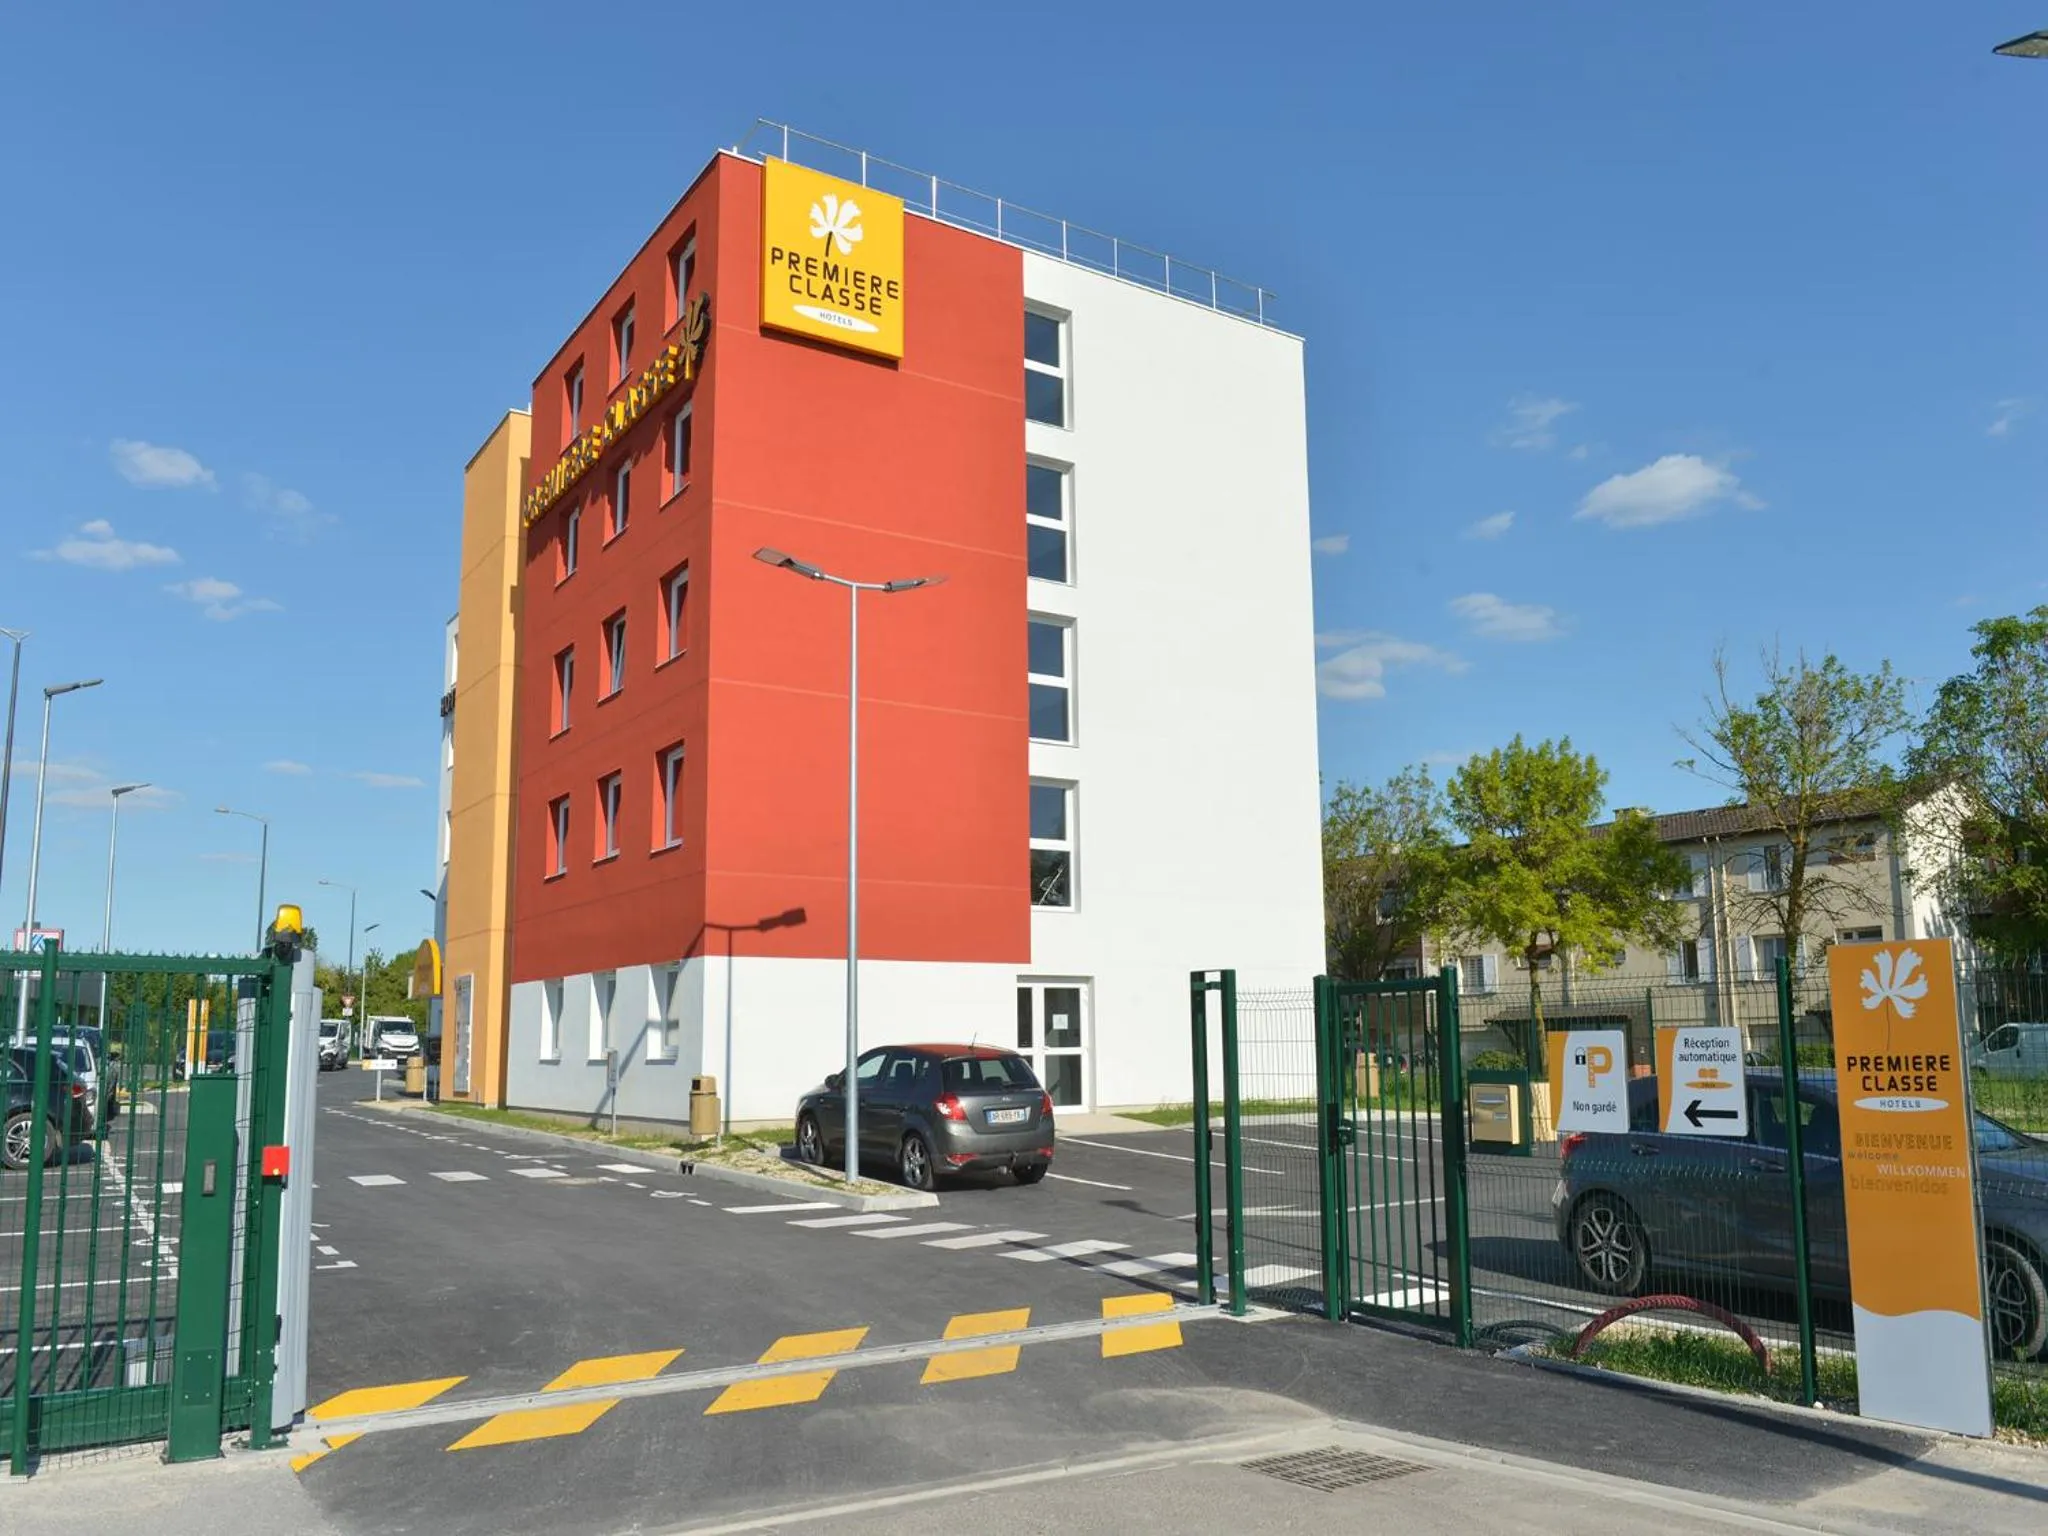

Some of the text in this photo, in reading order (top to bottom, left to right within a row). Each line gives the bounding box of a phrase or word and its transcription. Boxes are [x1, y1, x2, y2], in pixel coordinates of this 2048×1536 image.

[771, 246, 899, 300] PREMIERE
[789, 274, 882, 316] CLASSE
[819, 311, 853, 326] HOTELS
[1683, 1037, 1730, 1051] Réception
[1678, 1052, 1737, 1064] automatique
[1846, 1055, 1951, 1072] PREMIERE
[1862, 1075, 1937, 1092] CLASSE
[1572, 1100, 1617, 1114] Non gardé
[1879, 1099, 1921, 1109] HOTELS
[1855, 1132, 1953, 1151] BIENVENUE
[1847, 1150, 1900, 1161] welcome
[1876, 1163, 1966, 1178] WILLKOMMEN
[1850, 1174, 1949, 1195] bienvenidos
